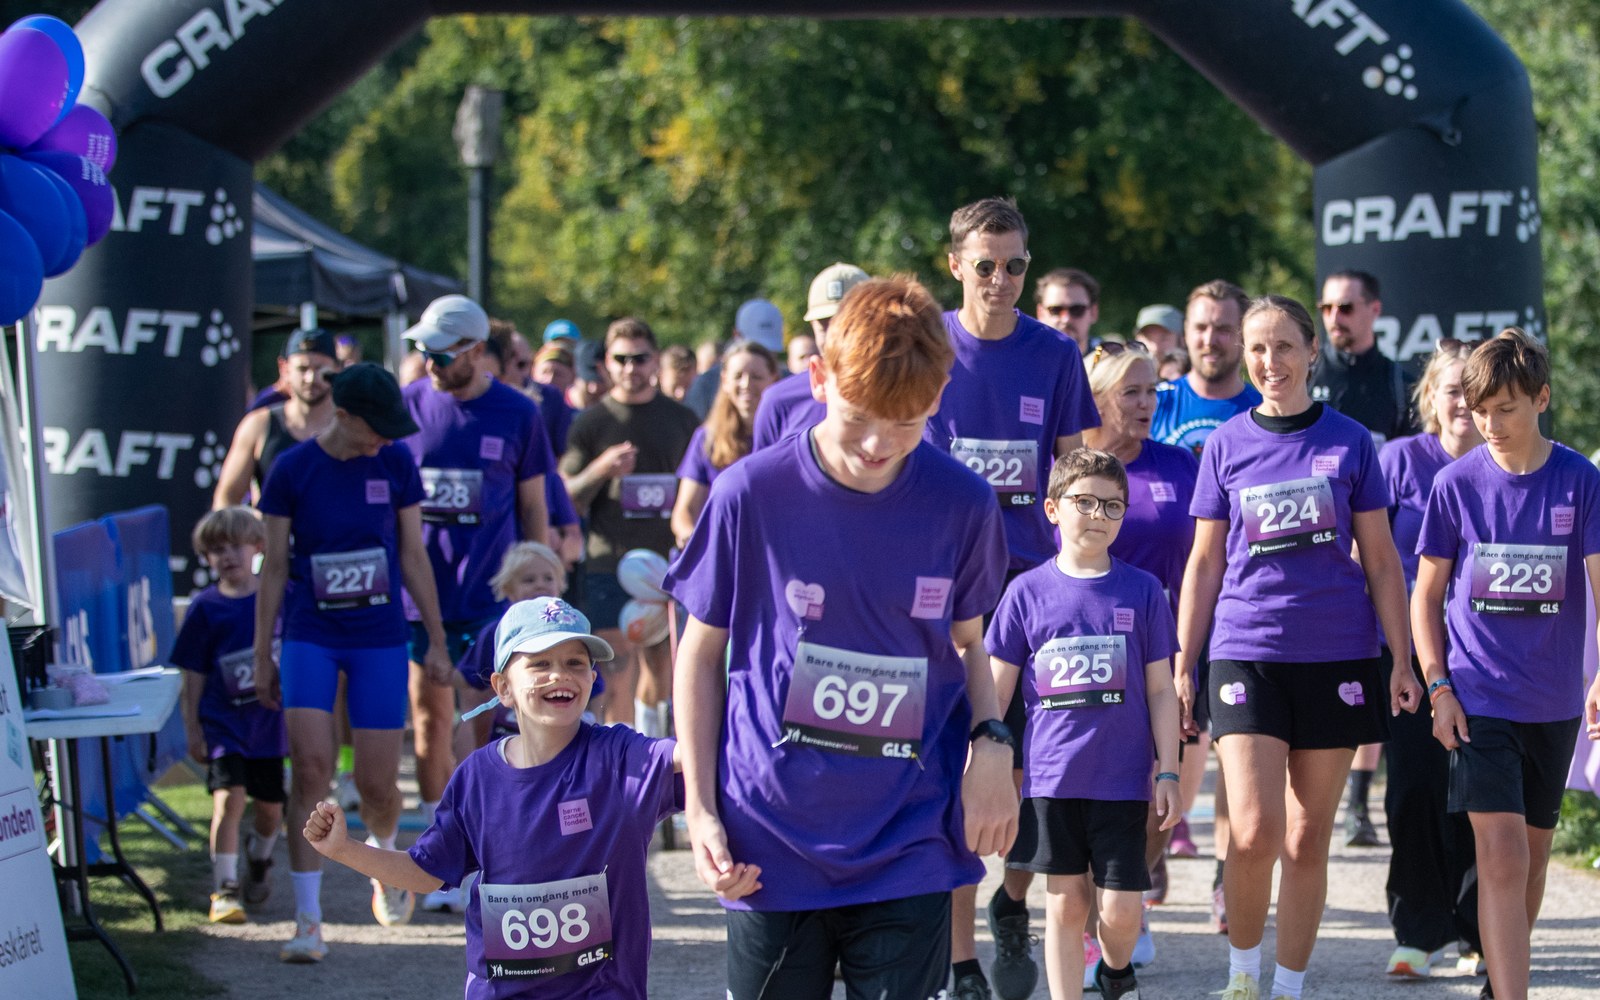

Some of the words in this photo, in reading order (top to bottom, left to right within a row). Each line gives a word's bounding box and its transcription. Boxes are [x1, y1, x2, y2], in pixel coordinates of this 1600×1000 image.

[140, 0, 285, 99] CRA
[1322, 190, 1513, 246] CRAFT
[36, 305, 200, 357] RAFT
[22, 427, 195, 479] RAFT
[966, 456, 1022, 486] 222
[1276, 487, 1304, 496] omgang
[1257, 496, 1320, 534] 224
[326, 565, 376, 594] 227
[1489, 562, 1552, 594] 223
[1068, 644, 1099, 652] omgang
[806, 656, 834, 669] Bare
[838, 661, 852, 671] én
[854, 664, 896, 679] omgang
[1049, 654, 1112, 688] 225
[813, 675, 908, 728] 697
[488, 895, 508, 903] Bare
[512, 895, 523, 903] én
[526, 890, 569, 904] omgang
[572, 884, 599, 896] mere
[502, 902, 590, 950] 698
